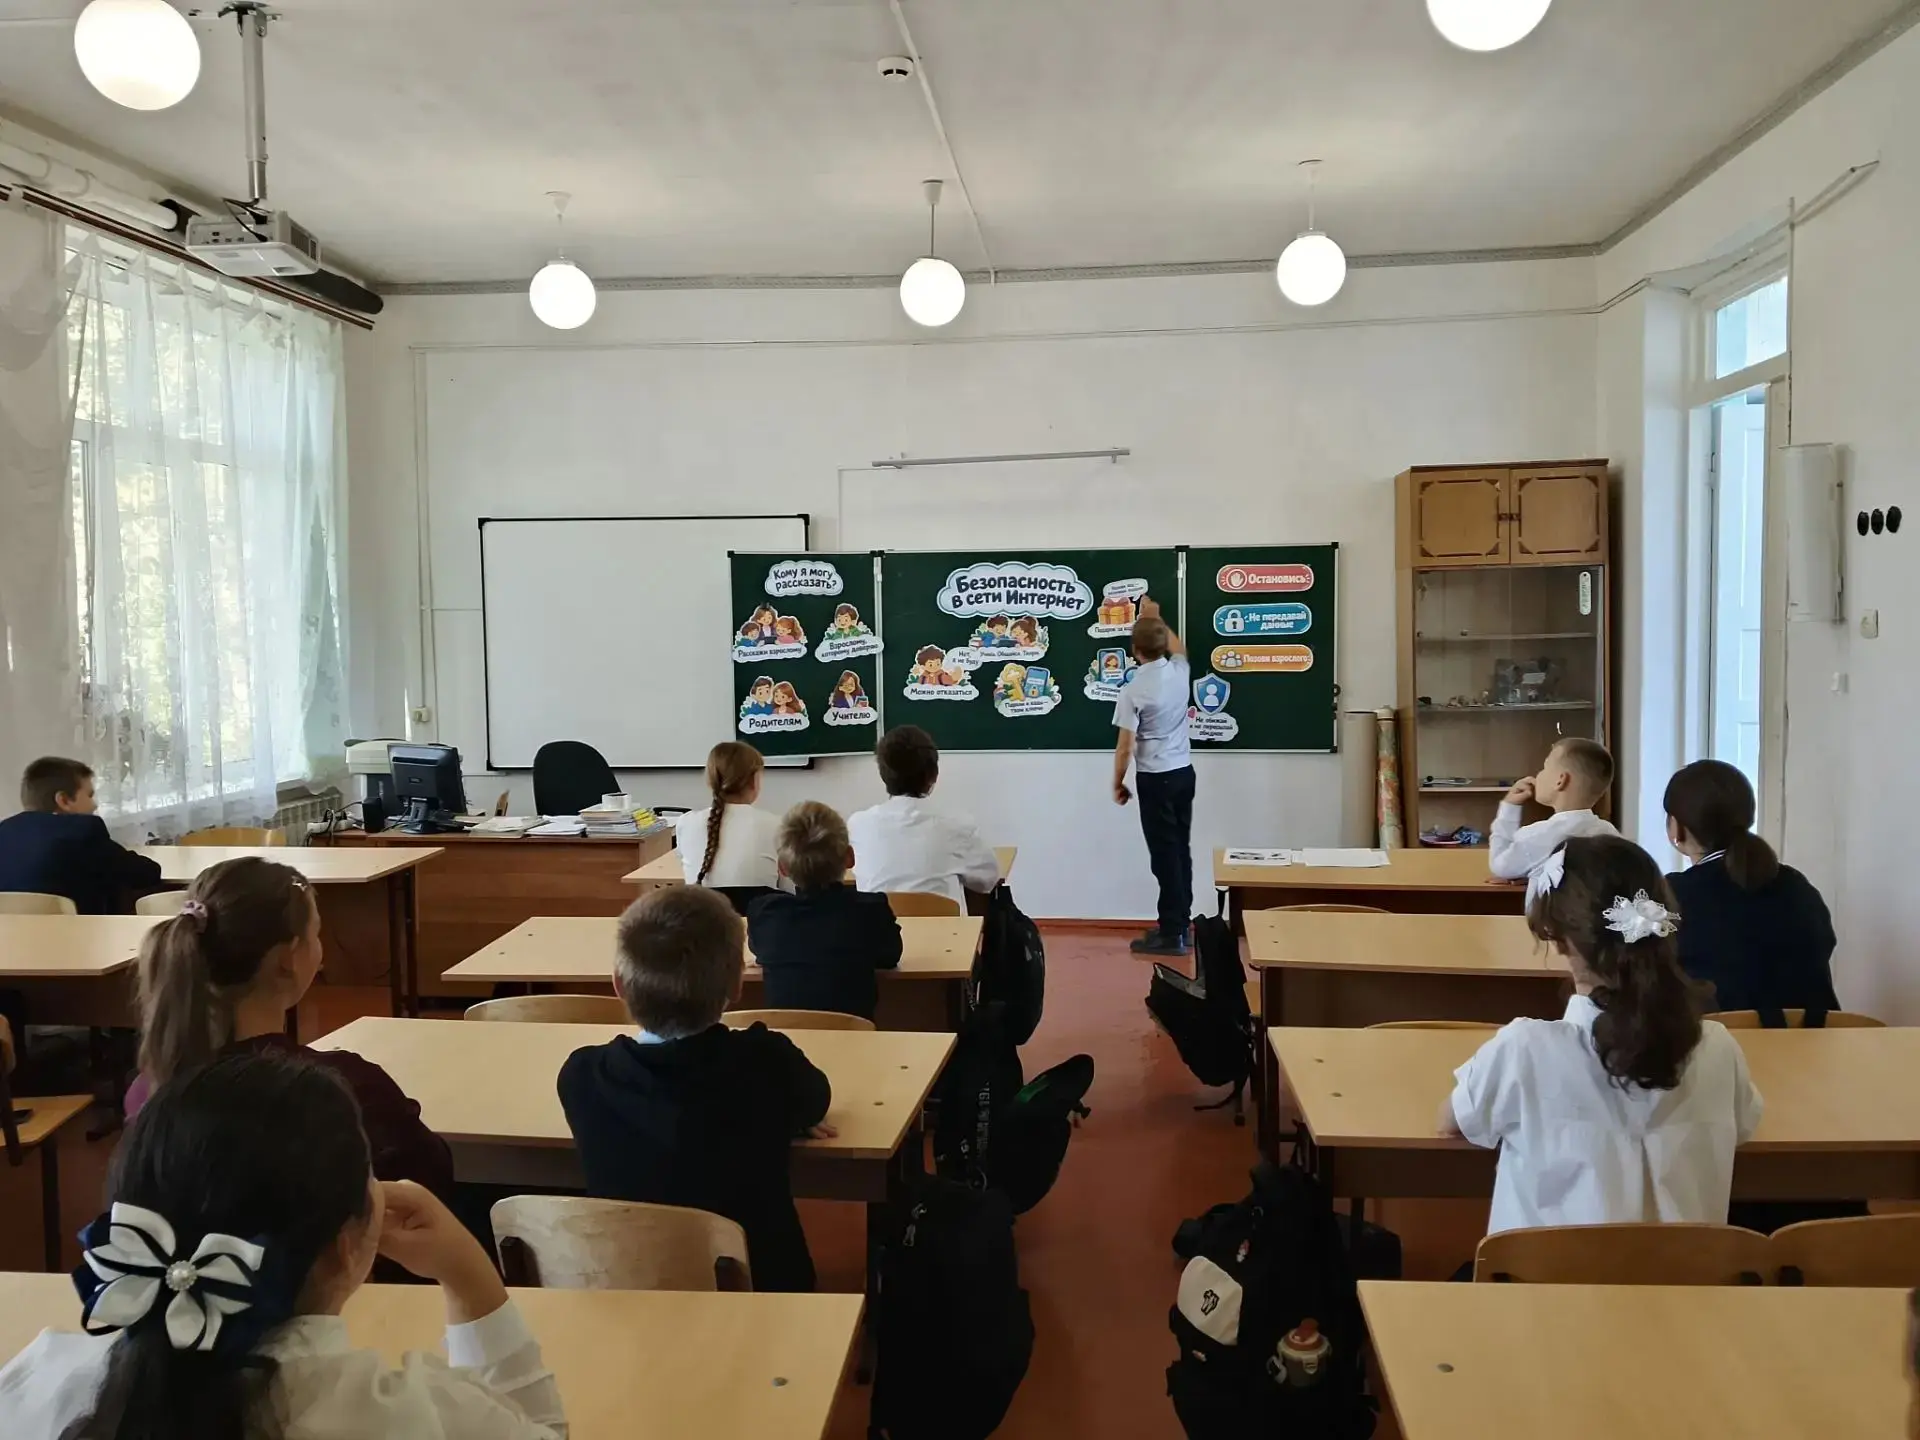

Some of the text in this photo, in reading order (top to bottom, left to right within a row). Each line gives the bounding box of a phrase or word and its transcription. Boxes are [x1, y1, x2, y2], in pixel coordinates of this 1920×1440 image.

[774, 568, 834, 580] Кому я могу
[1248, 573, 1306, 584] Остановись
[776, 580, 837, 592] рассказать?
[956, 575, 1076, 594] Безопасность
[952, 590, 1085, 611] в сети Интернет
[1249, 611, 1306, 622] Не передавай
[1260, 621, 1294, 630] данные
[738, 647, 802, 658] Расскажи взрослому
[822, 648, 850, 658] которому
[910, 688, 972, 696] Можно отказаться
[832, 710, 870, 722] Учителю
[749, 718, 802, 728] Родителям
